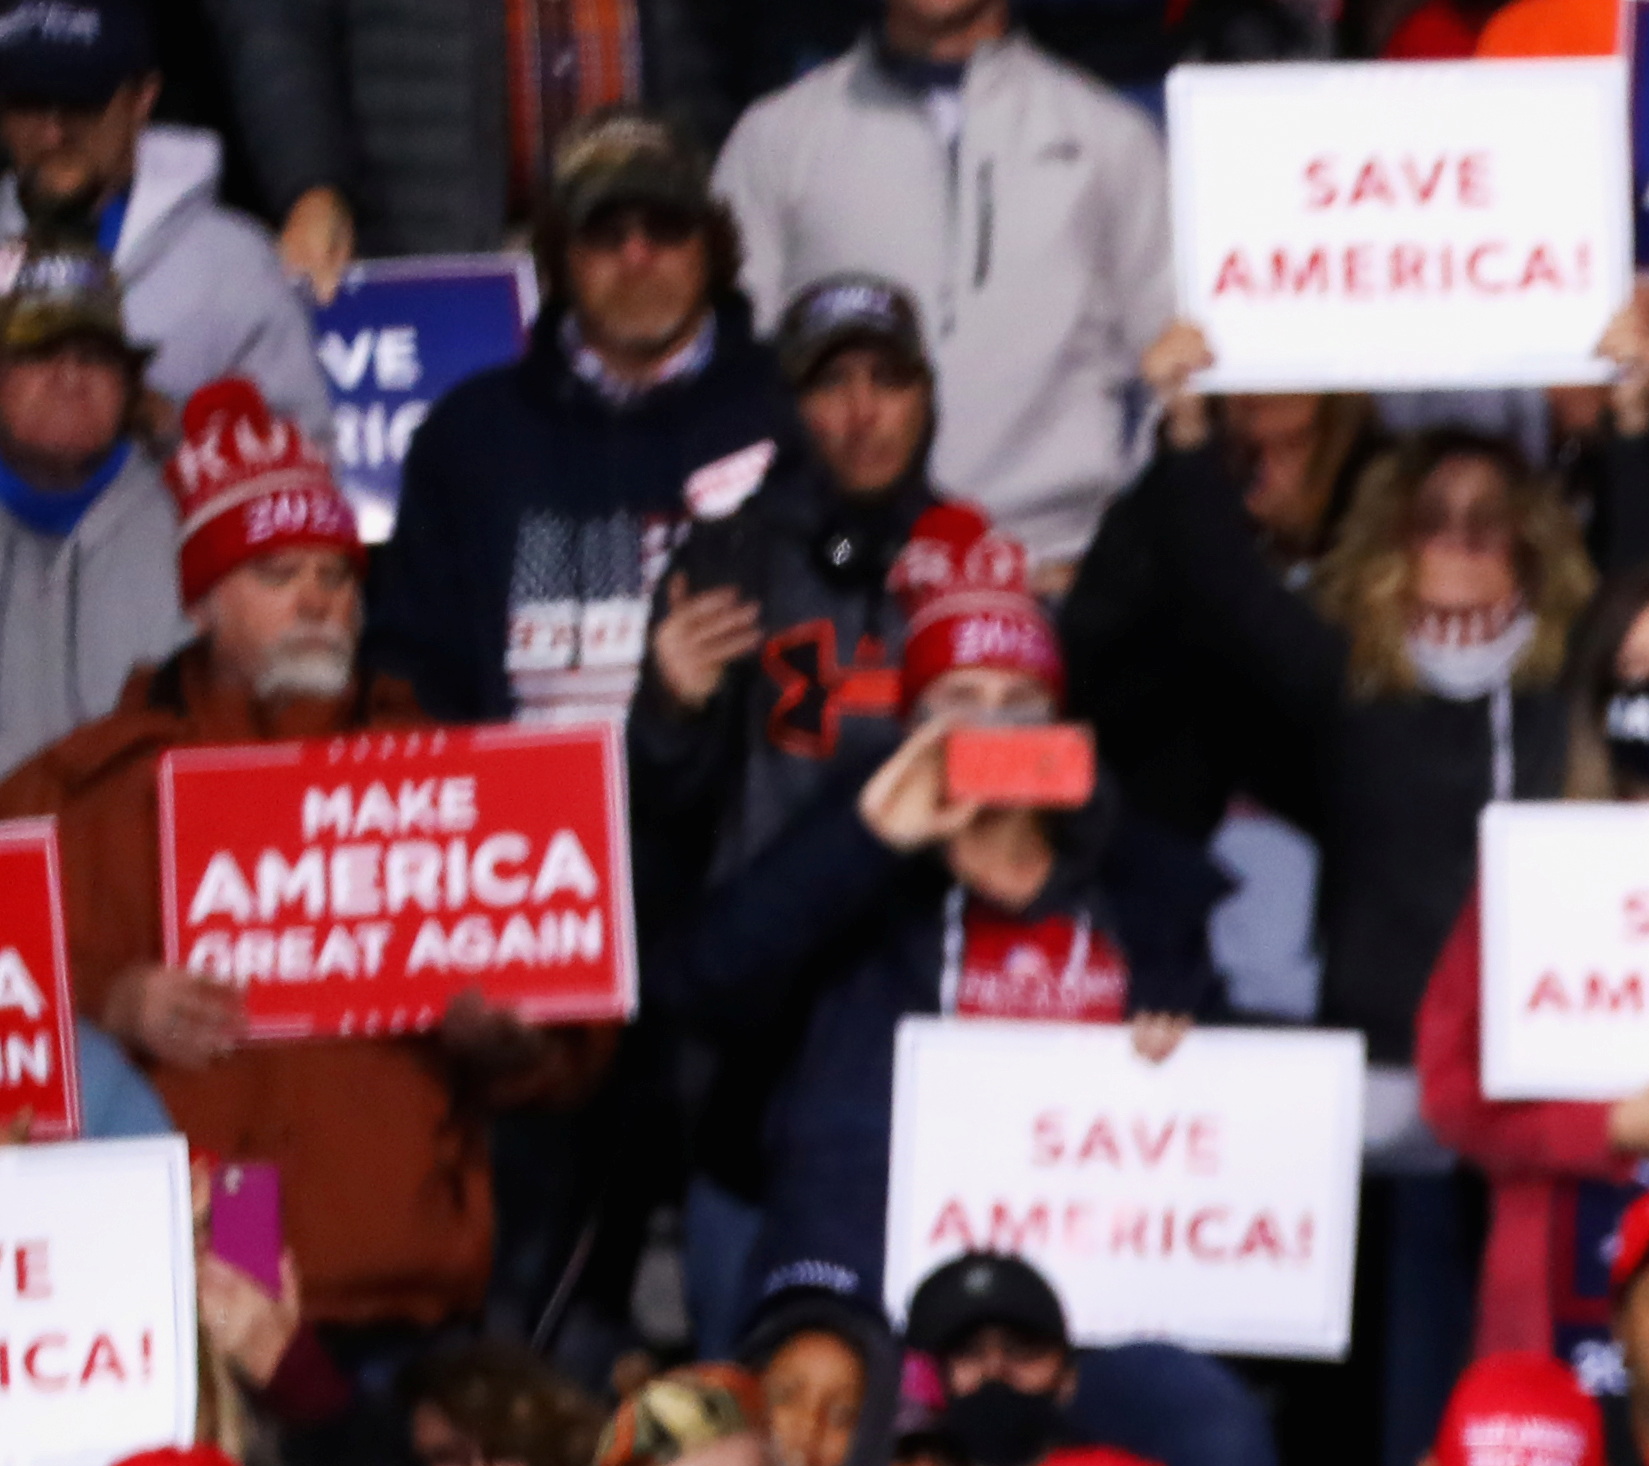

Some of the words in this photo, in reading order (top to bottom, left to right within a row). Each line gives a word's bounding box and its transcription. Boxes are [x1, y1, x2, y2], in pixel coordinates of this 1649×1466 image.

[1300, 151, 1496, 211] SAVE
[1211, 240, 1594, 300] AMERICA!
[302, 776, 478, 841] MAKE
[188, 828, 599, 926] AMERICA
[186, 922, 395, 988] GREAT
[405, 908, 604, 976] AGAIN
[1030, 1110, 1222, 1175] SAVE
[928, 1197, 1315, 1263] AMERICA!
